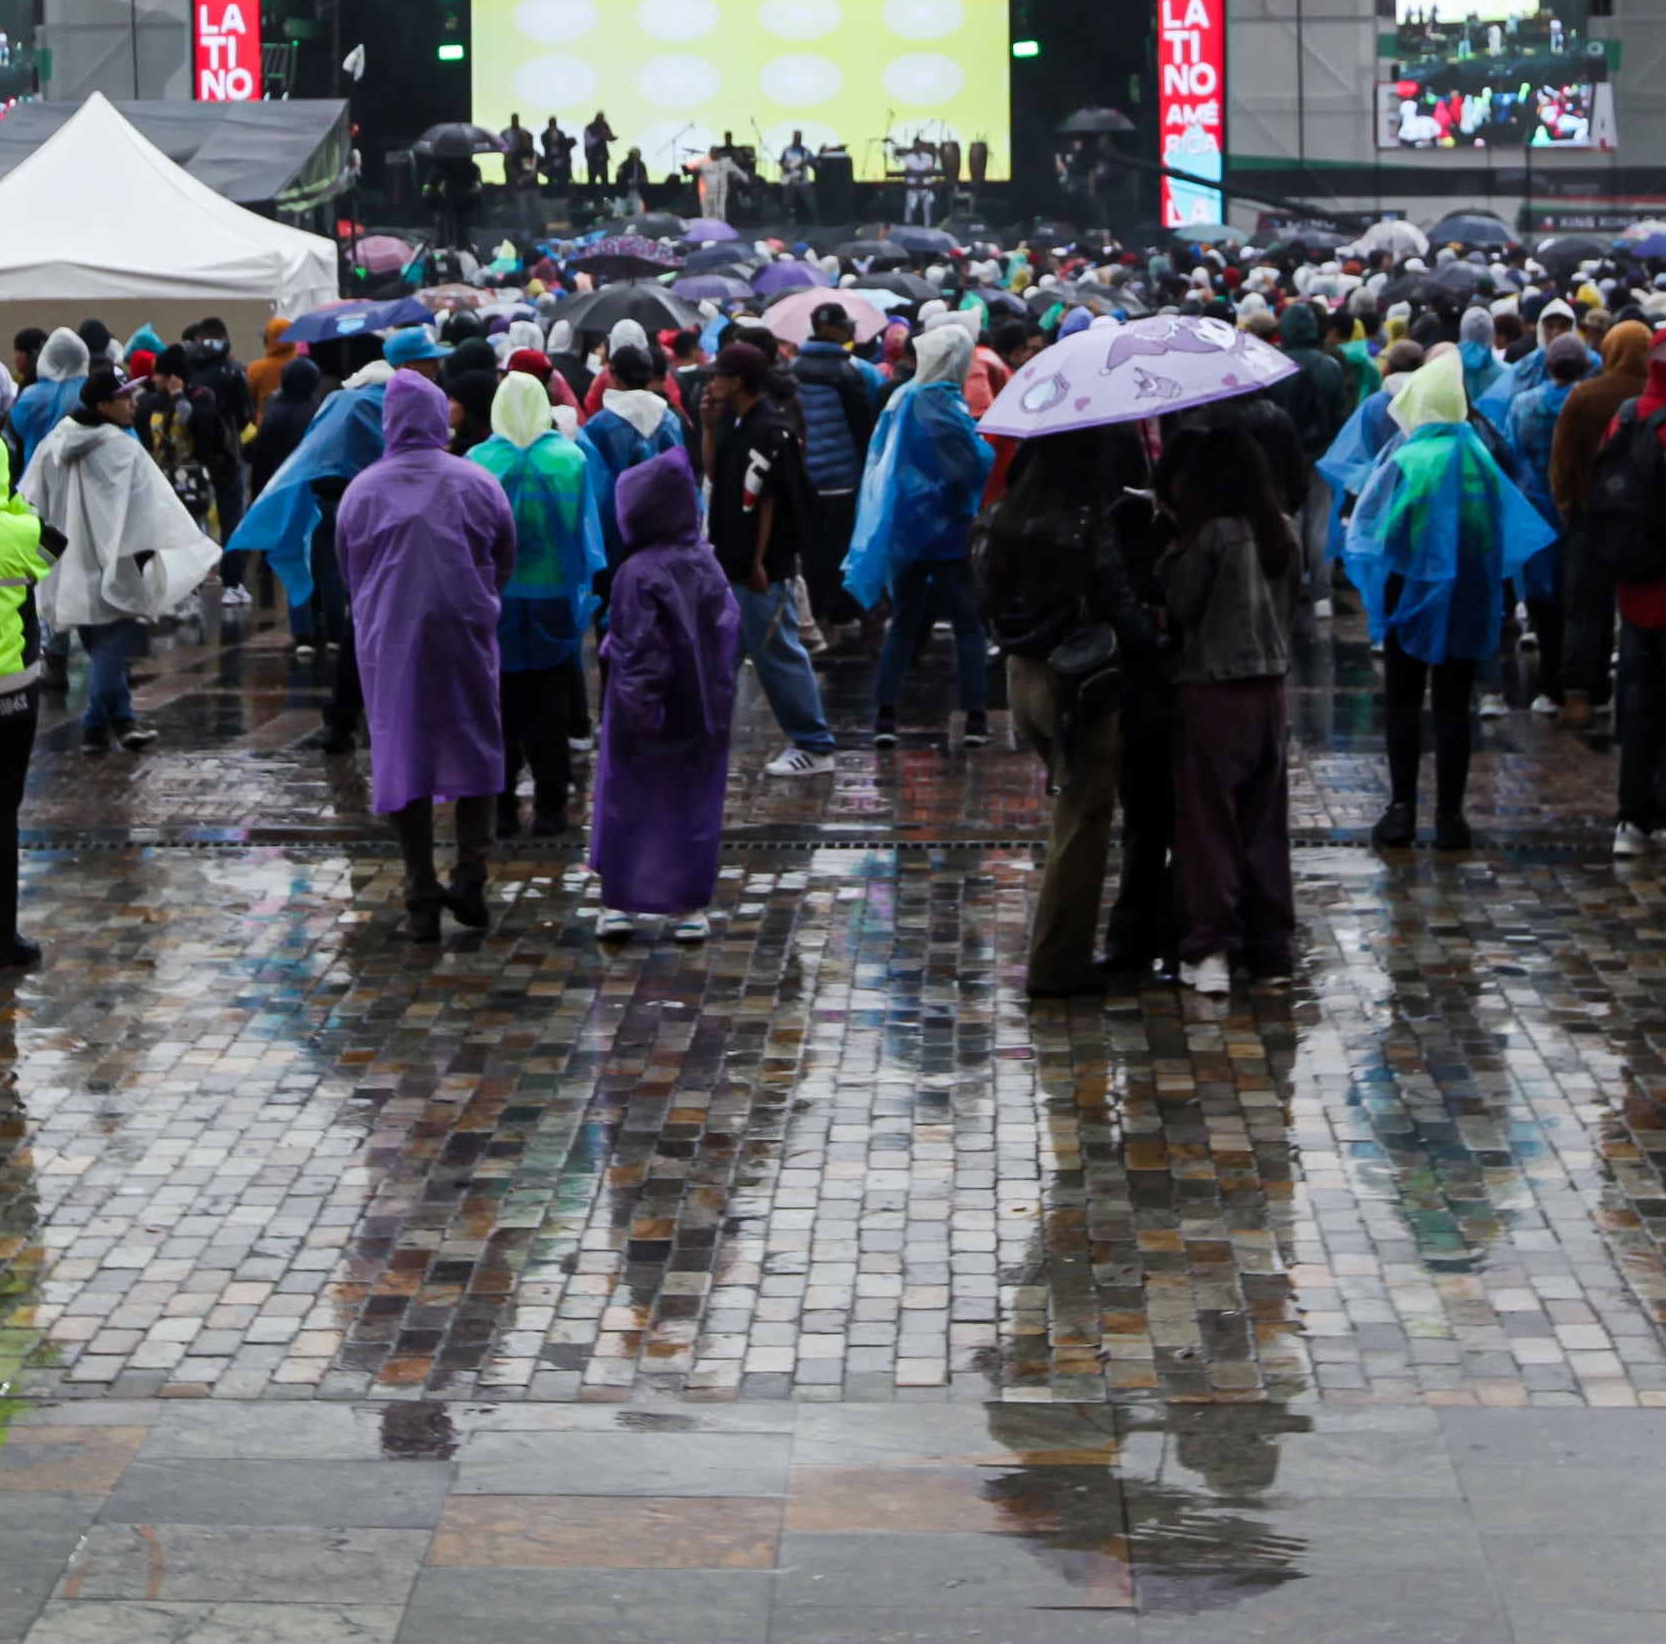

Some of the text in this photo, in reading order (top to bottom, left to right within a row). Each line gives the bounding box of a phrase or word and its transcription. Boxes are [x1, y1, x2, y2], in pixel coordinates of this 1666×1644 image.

[199, 3, 246, 35] LA
[200, 35, 237, 70] TI
[1164, 30, 1201, 64] TI
[201, 68, 253, 101] NO
[1164, 63, 1217, 96] NO
[1166, 101, 1220, 126] AMÉ
